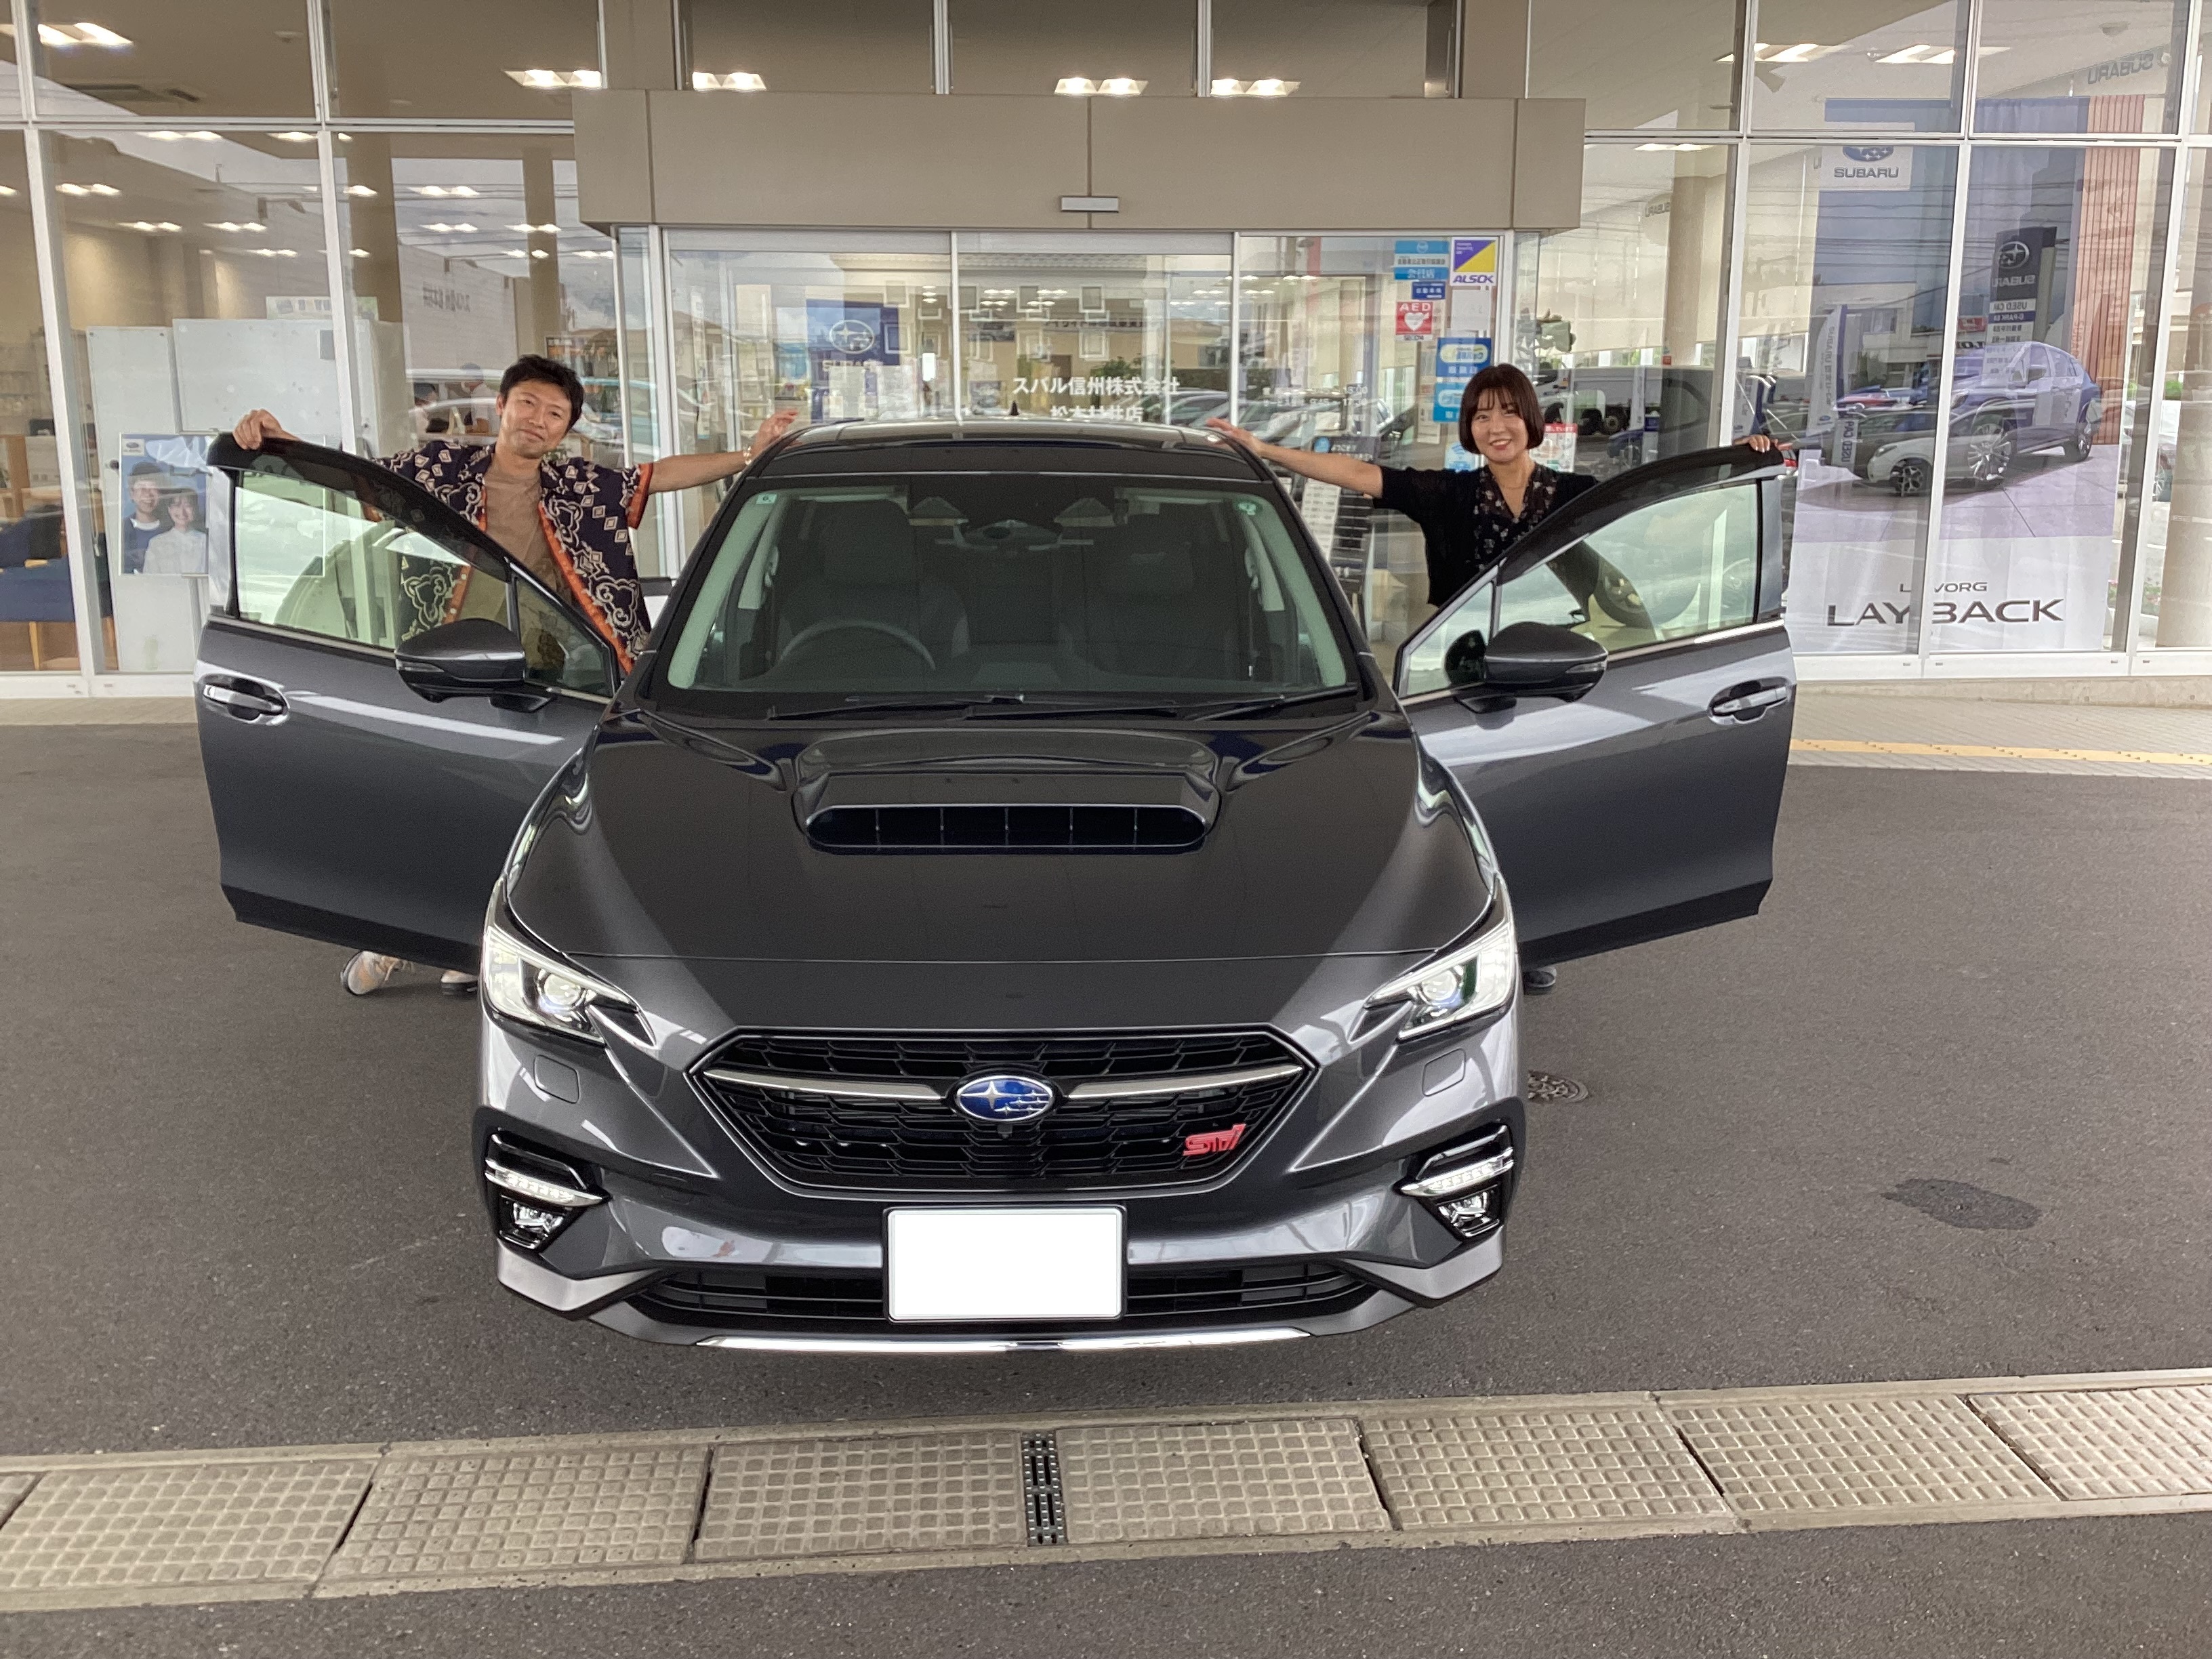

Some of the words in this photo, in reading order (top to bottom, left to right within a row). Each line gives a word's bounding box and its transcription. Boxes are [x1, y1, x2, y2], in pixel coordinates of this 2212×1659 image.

[1834, 167, 1899, 178] SUBARU
[1452, 274, 1494, 284] ALSOK
[1399, 302, 1432, 312] AED
[1012, 376, 1181, 396] スバル信州株式会社
[1900, 581, 1988, 594] LVORG
[1827, 598, 2064, 626] LAYBACK
